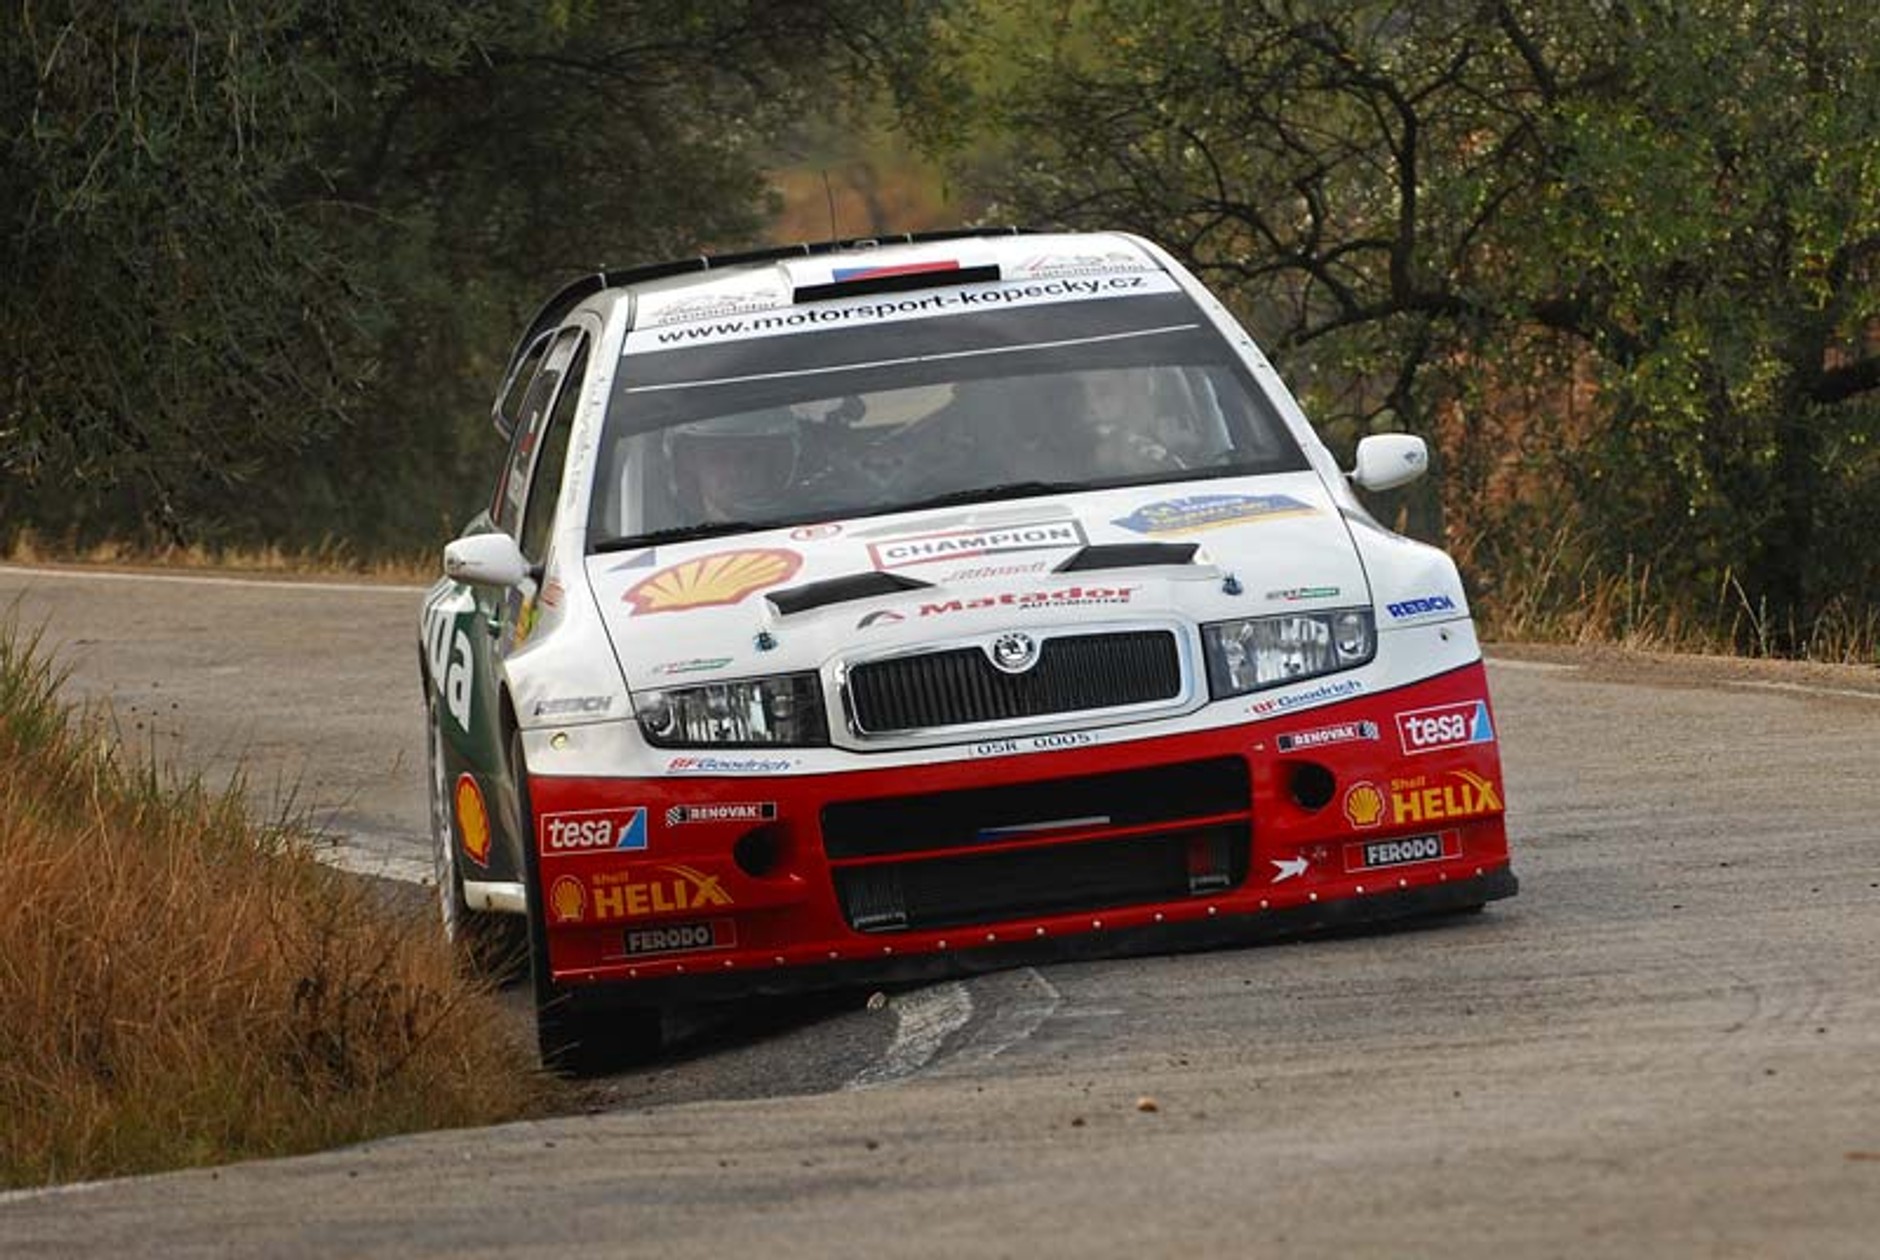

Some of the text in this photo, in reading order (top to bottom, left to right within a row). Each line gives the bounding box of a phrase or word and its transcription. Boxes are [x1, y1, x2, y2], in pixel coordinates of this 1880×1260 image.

[657, 276, 1146, 344] www.motorsport-kopecky.cz
[887, 527, 1072, 560] CHAMPION
[919, 586, 1133, 617] Matador
[1405, 713, 1466, 746] tesa
[1391, 775, 1426, 791] Shell
[1391, 769, 1504, 824] HELIX
[547, 818, 613, 848] tesa
[1367, 837, 1438, 866] FERODO
[591, 864, 735, 919] HELIX
[628, 926, 709, 951] FERODO
